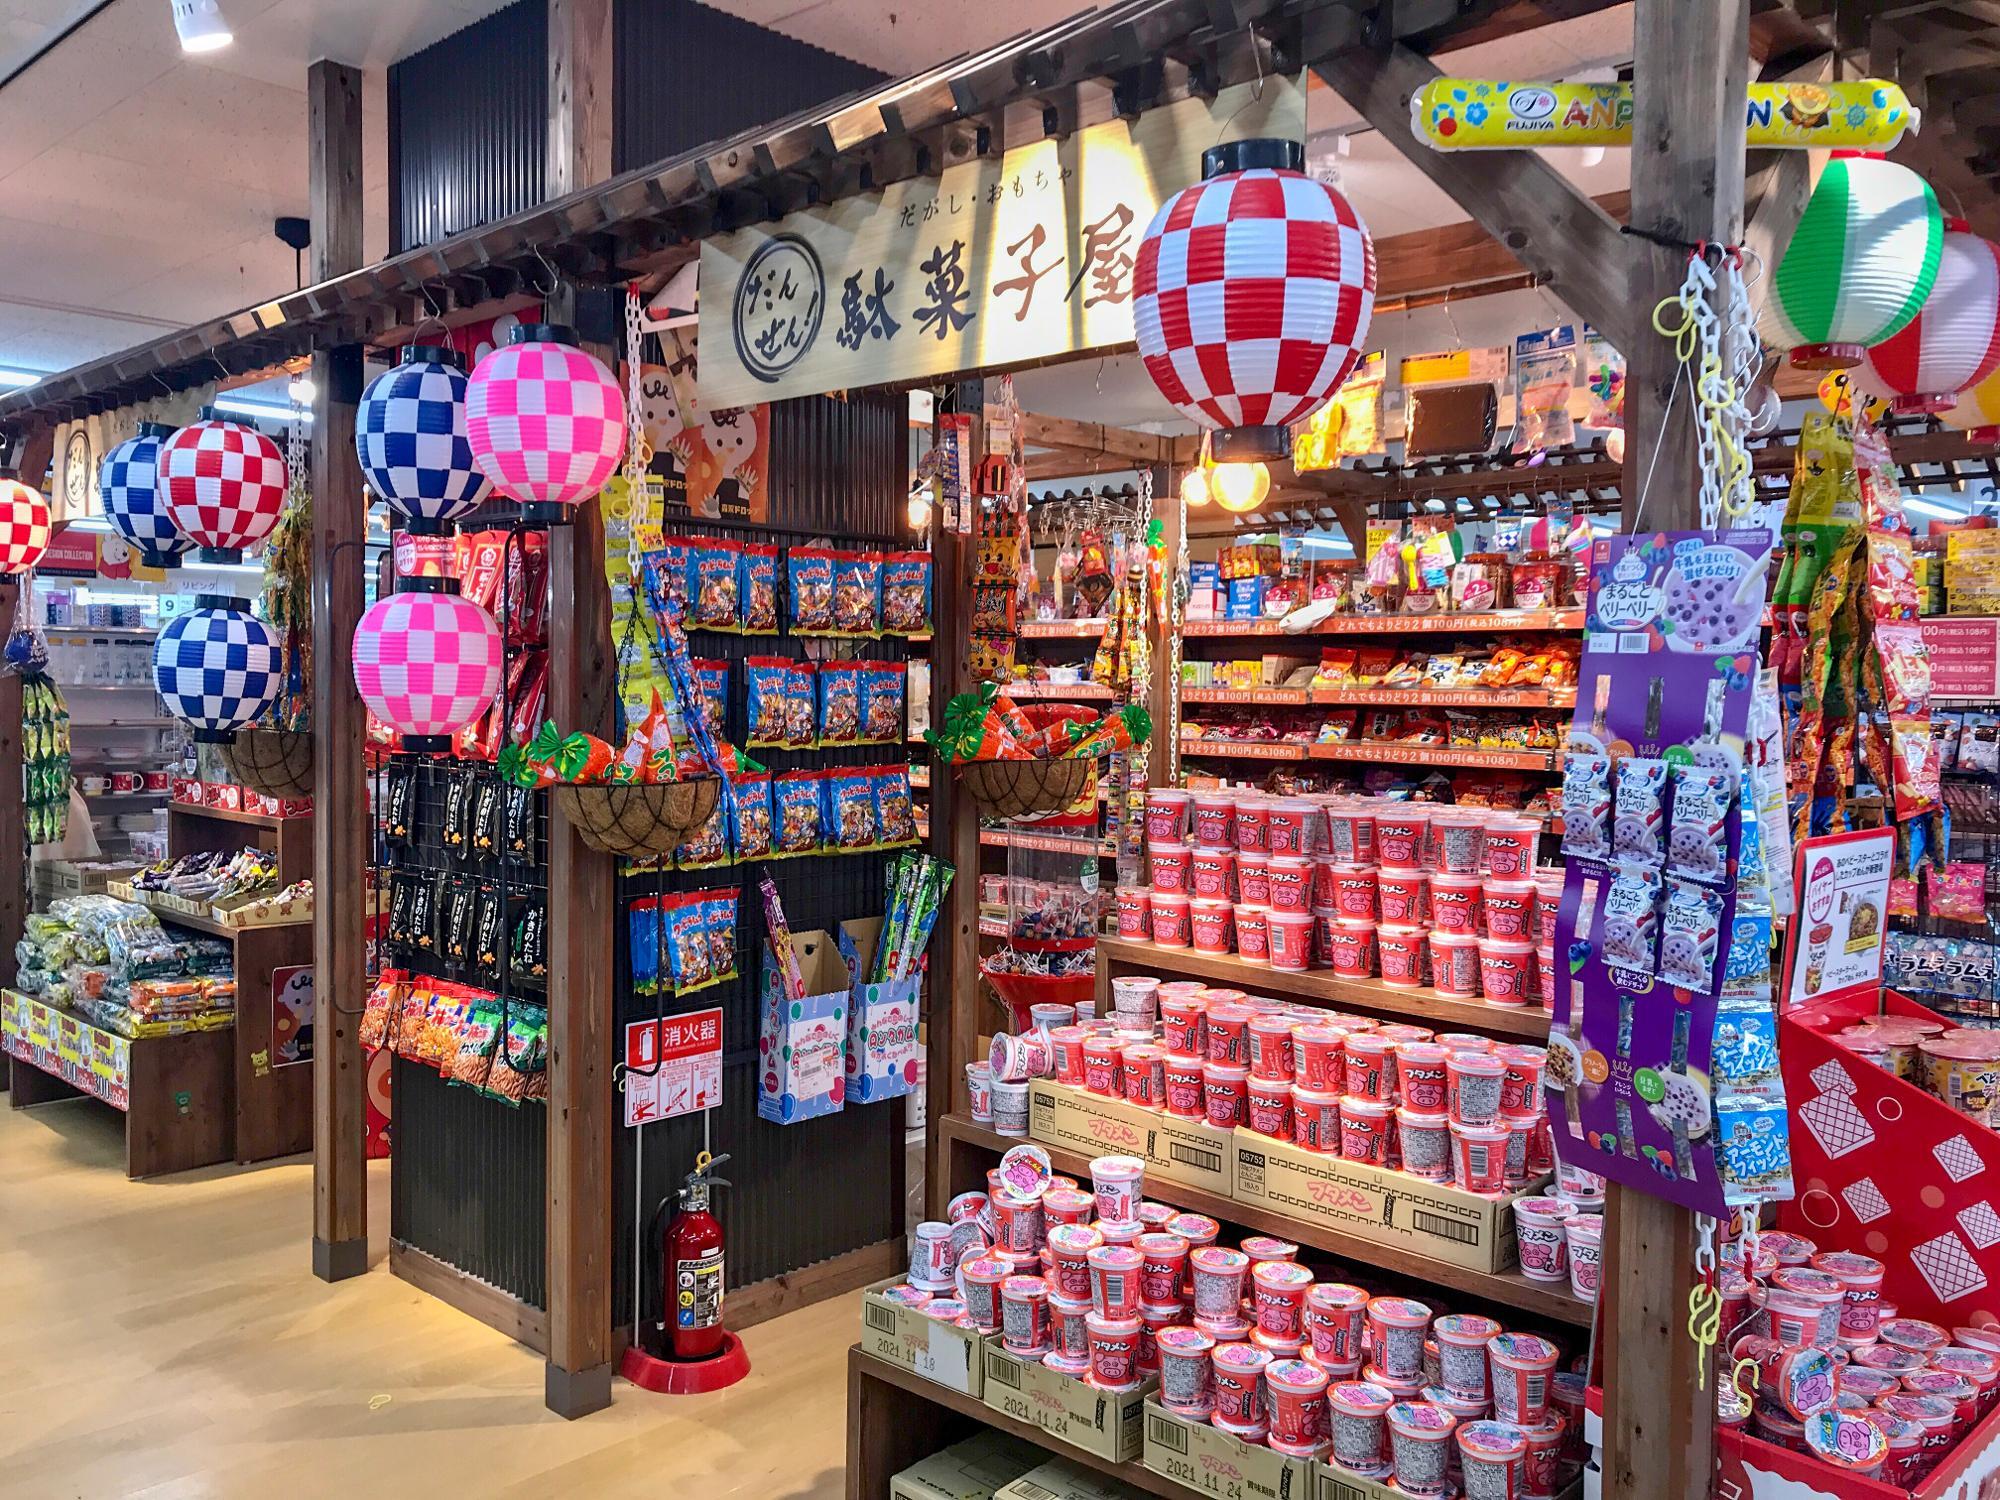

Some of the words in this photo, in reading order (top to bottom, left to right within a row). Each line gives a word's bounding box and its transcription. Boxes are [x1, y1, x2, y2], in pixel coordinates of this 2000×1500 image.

[1506, 120, 1554, 131] FUJIYA
[836, 202, 1134, 352] 駄菓子屋
[64, 550, 94, 560] COLLECTION
[183, 582, 215, 591] リビング
[1606, 582, 1650, 599] まるごと
[166, 600, 174, 611] 9
[1600, 601, 1655, 618] ベリーベリー
[1565, 783, 1591, 793] まるごと
[1619, 788, 1648, 800] まるごと
[1676, 796, 1708, 809] まるごと
[1612, 888, 1641, 902] まるごと
[524, 909, 538, 964] かきのたね
[664, 1019, 716, 1048] 消火器
[1036, 1095, 1054, 1107] 05752
[1088, 1119, 1140, 1146] ブタメン
[1727, 1132, 1787, 1165] アーモンド
[1240, 1151, 1264, 1166] 05752
[1735, 1152, 1790, 1179] フィッシュ
[1307, 1181, 1373, 1213] ブタメン
[878, 1338, 936, 1372] 2021.11.18
[1004, 1396, 1068, 1435] 2021.11.24
[1167, 1458, 1242, 1500] 2021.11.24
[1247, 1479, 1276, 1499] 賞味期限
